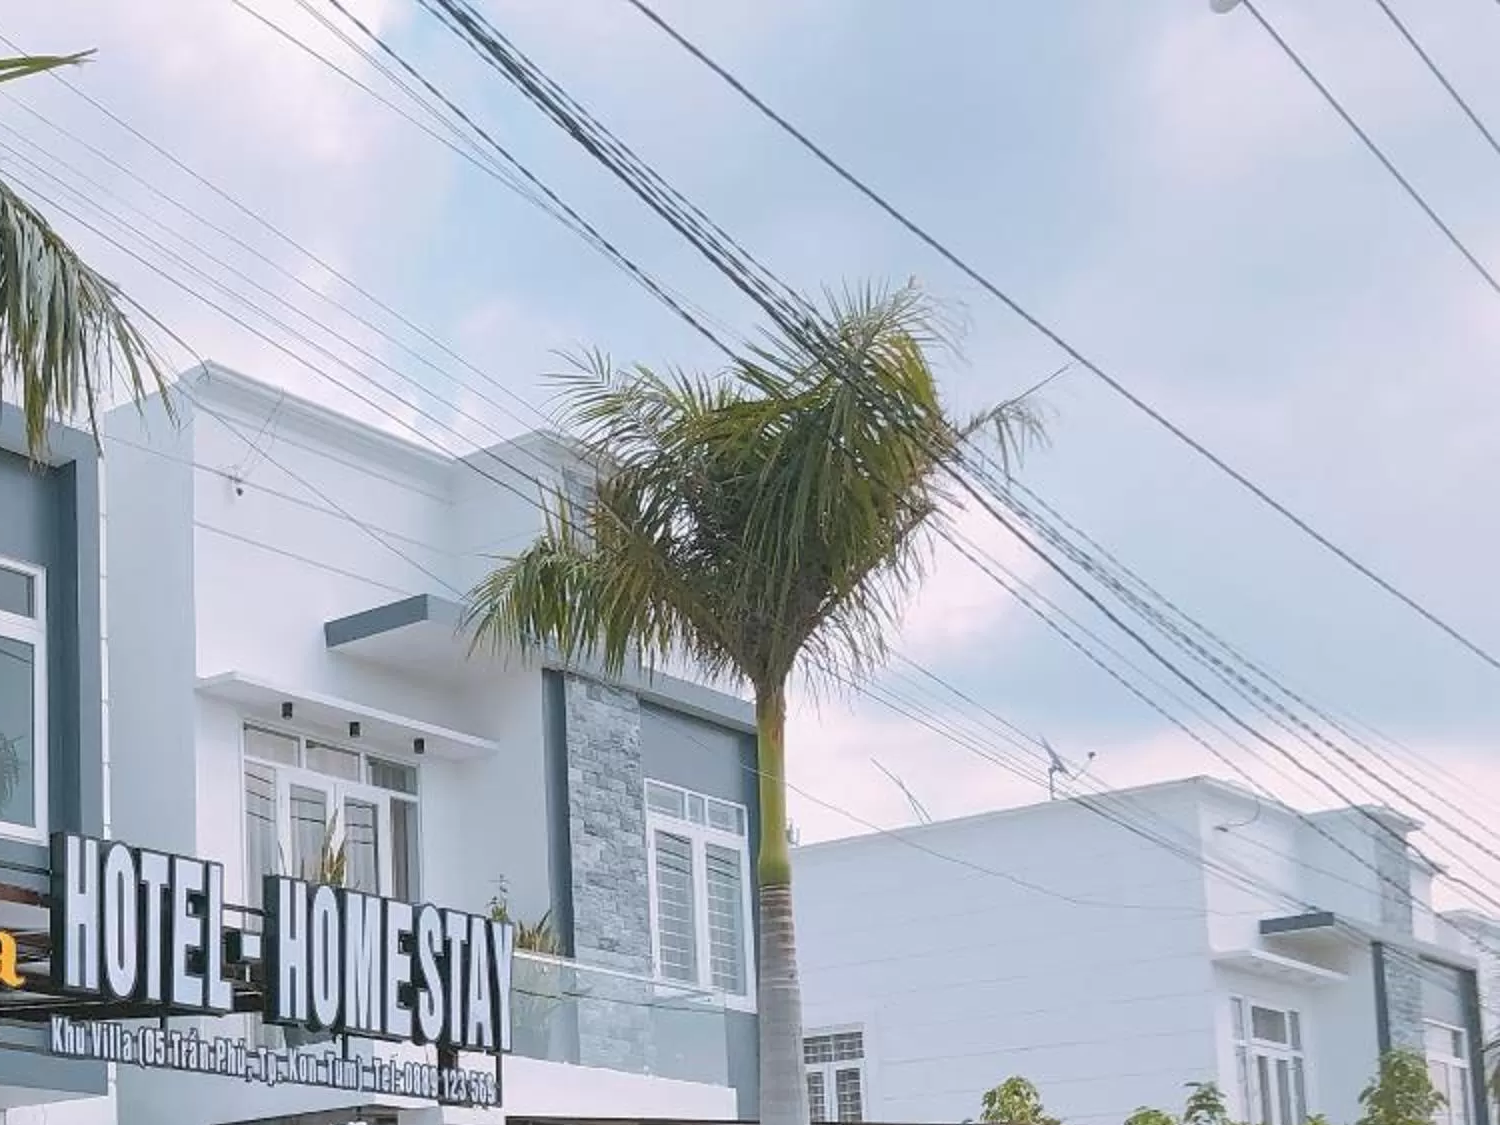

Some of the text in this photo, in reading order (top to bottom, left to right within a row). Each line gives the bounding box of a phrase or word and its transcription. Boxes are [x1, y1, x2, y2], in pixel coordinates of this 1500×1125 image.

[63, 834, 234, 1012] HOTEL
[278, 876, 514, 1052] HOMESTAY
[51, 1015, 86, 1055] Khu
[91, 1021, 133, 1061] Villa
[288, 1047, 318, 1084] Kon
[442, 1067, 467, 1102] 123
[469, 1071, 497, 1106] 569
